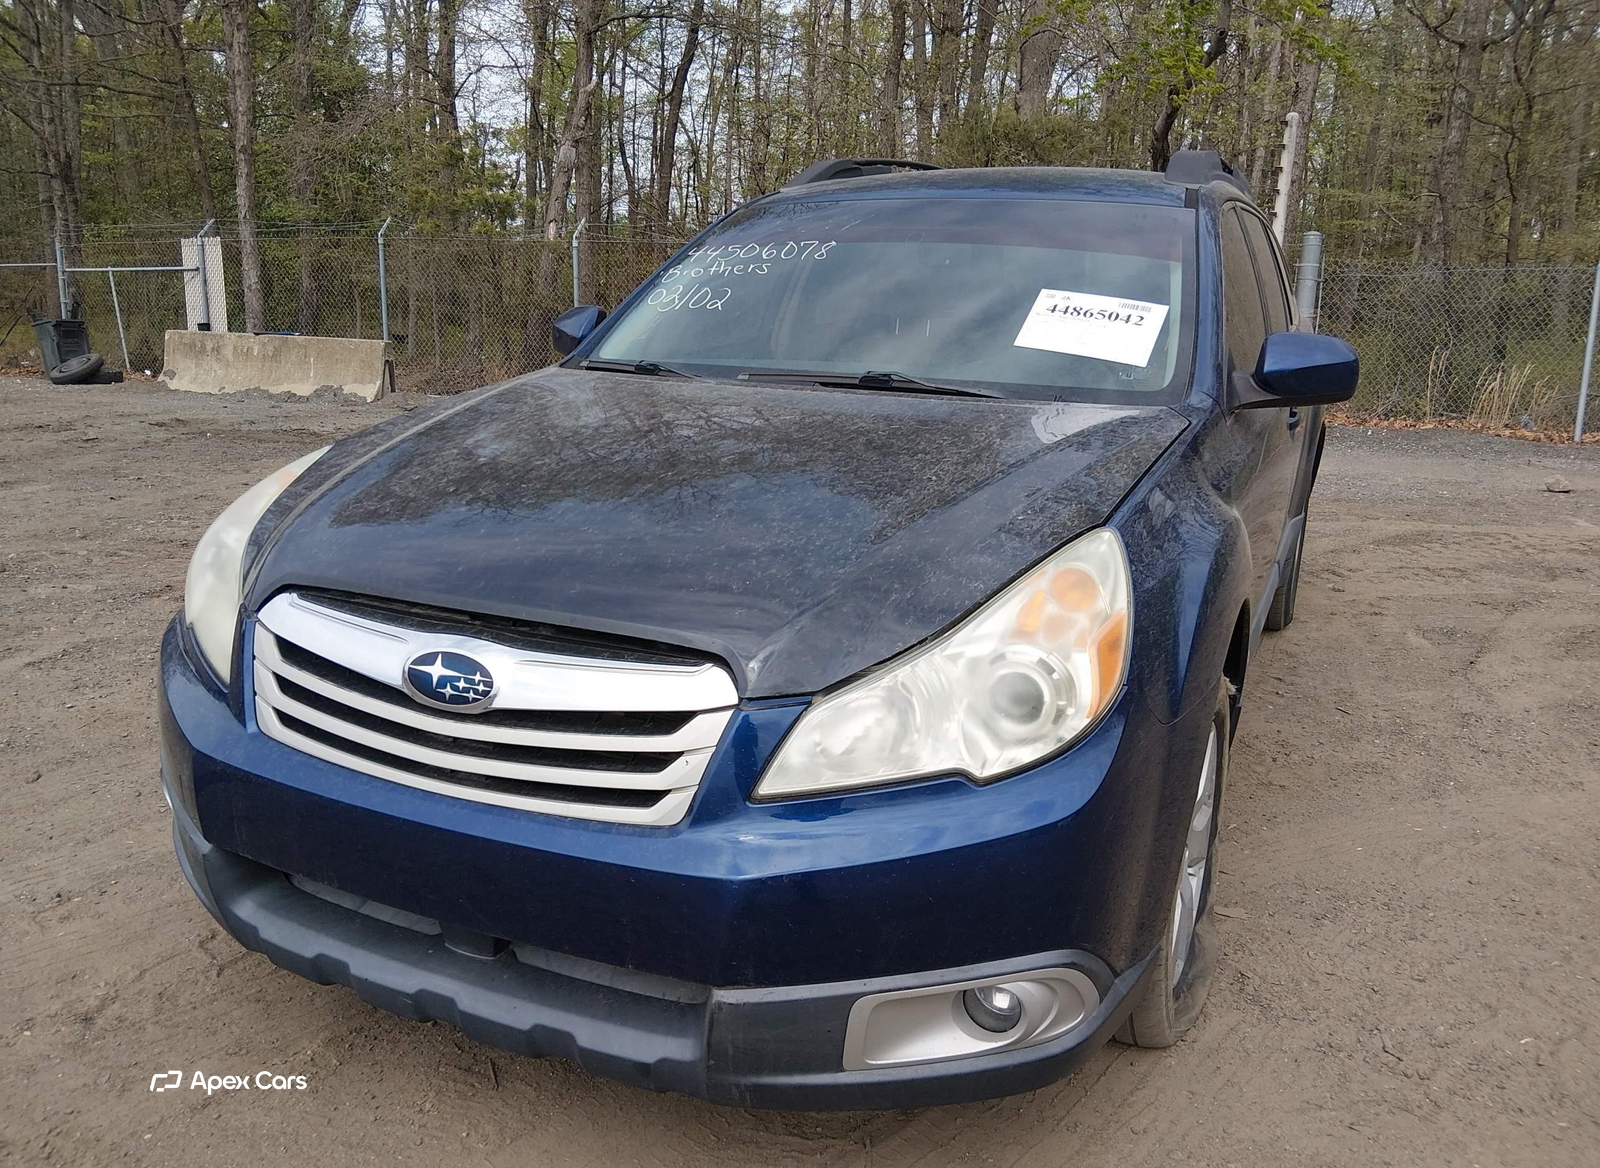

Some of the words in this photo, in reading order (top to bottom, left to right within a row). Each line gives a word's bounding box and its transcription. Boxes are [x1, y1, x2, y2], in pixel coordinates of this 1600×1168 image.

[689, 240, 837, 263] 44506078
[661, 261, 771, 283] Brothers
[1046, 304, 1145, 326] 44865042
